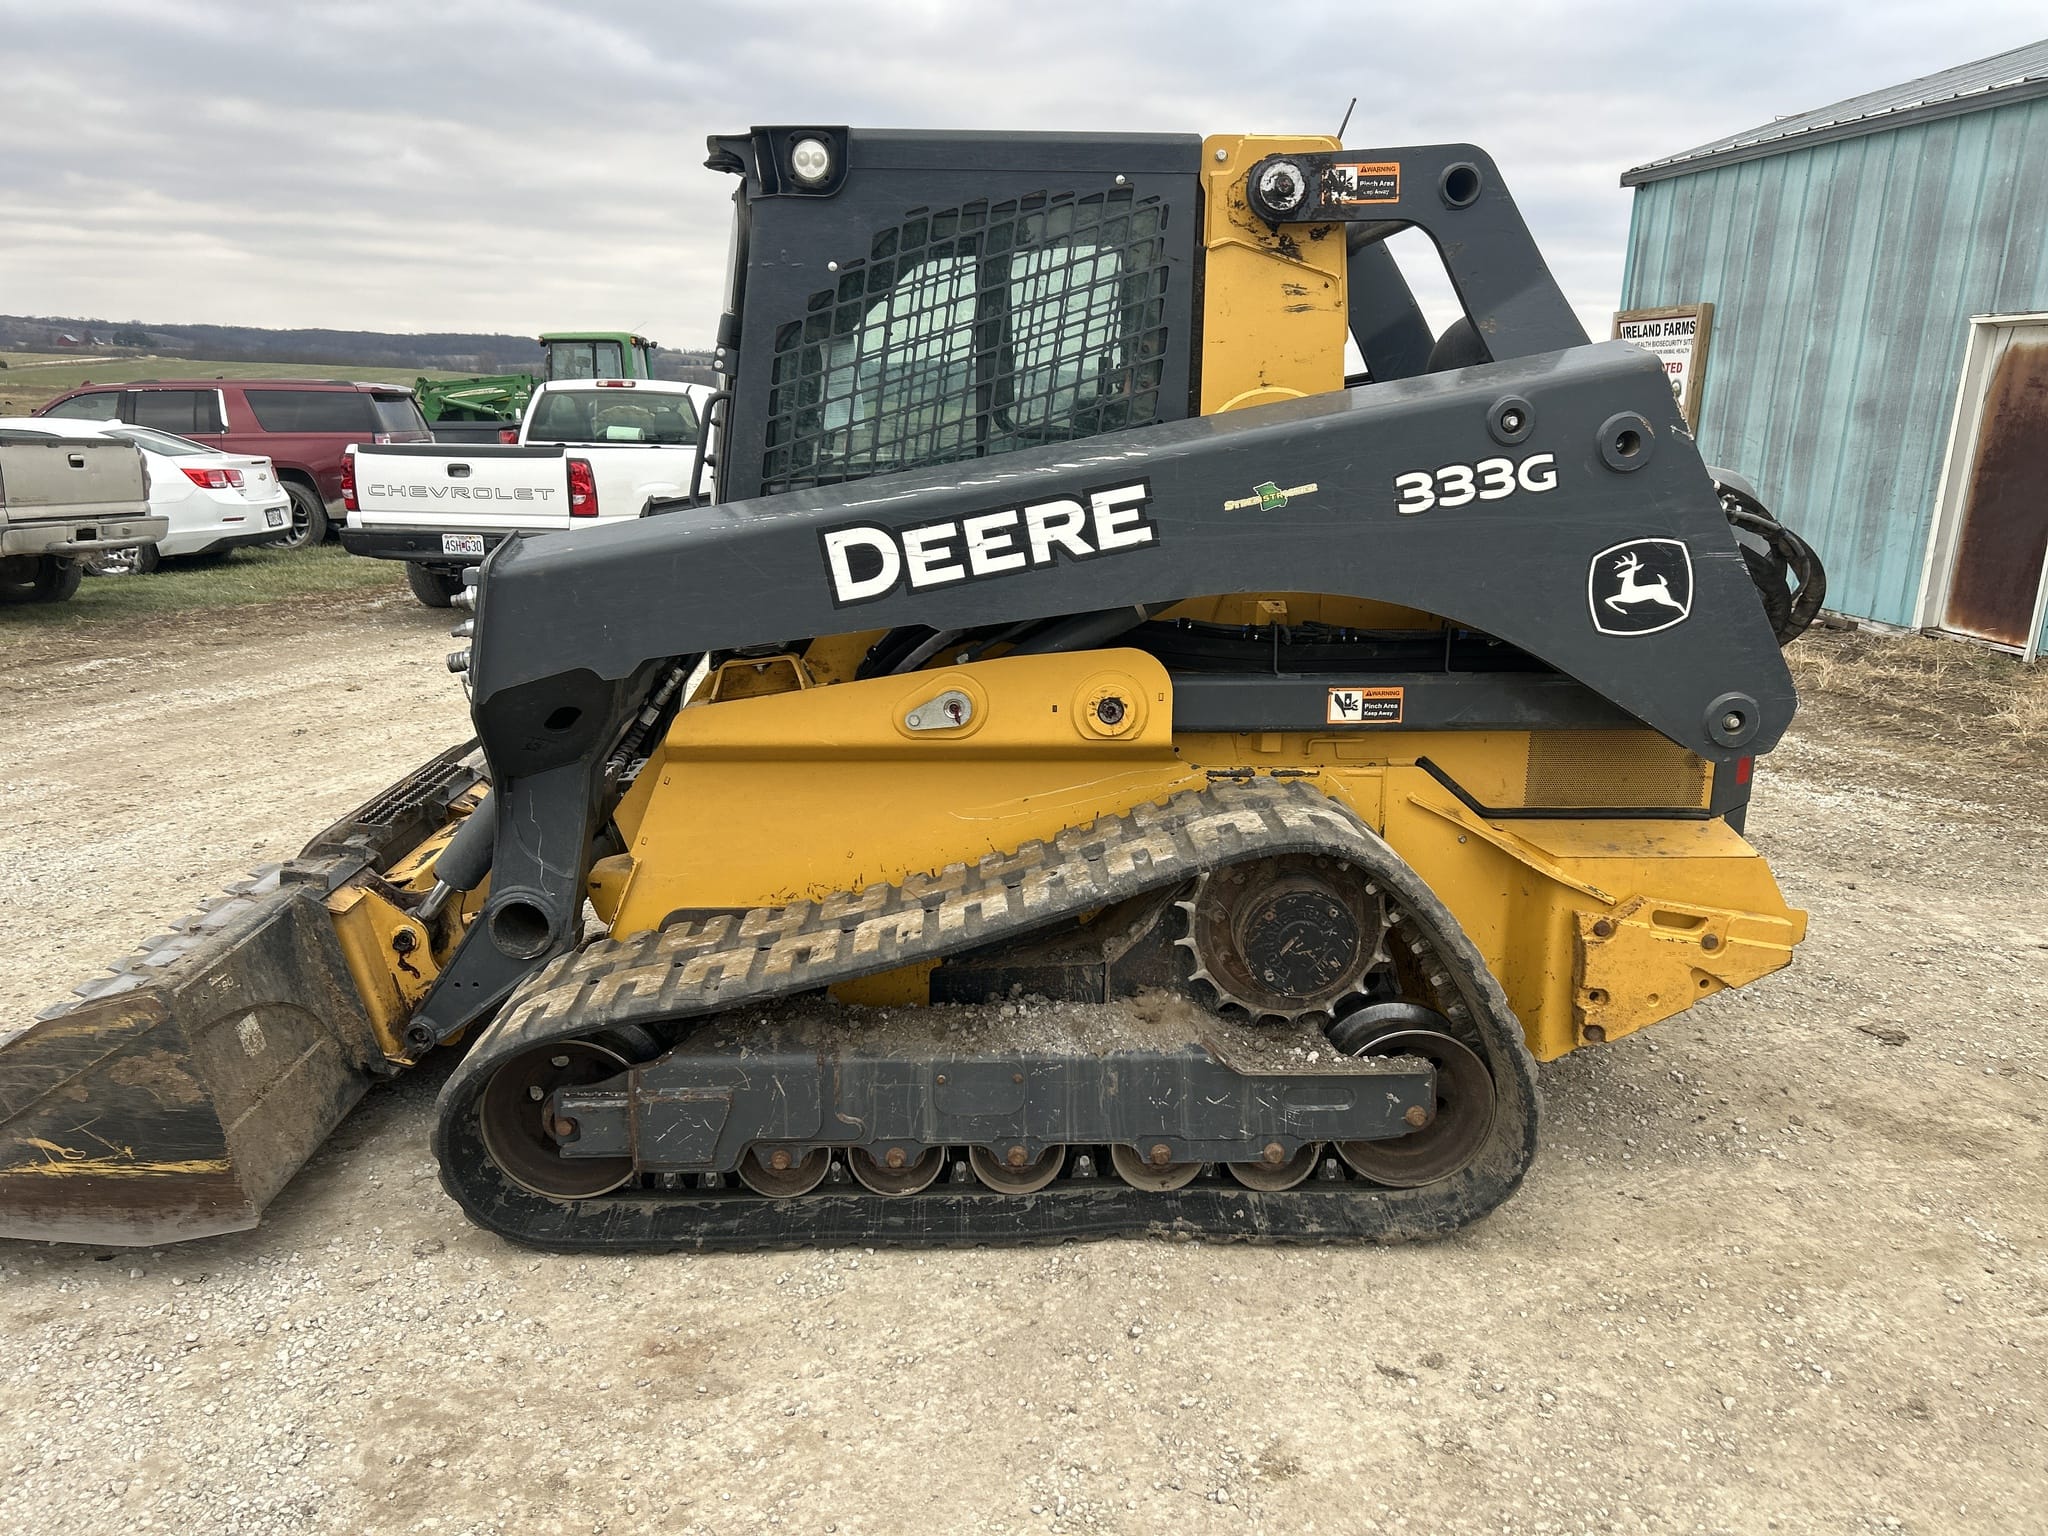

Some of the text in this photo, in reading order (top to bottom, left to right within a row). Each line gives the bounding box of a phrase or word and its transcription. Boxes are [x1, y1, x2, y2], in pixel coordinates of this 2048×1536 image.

[1622, 320, 1696, 339] IRELAND FARMS
[1652, 339, 1682, 348] BIOSECURITY
[1396, 453, 1557, 513] 333G
[368, 484, 555, 500] CHEVROLET
[445, 540, 482, 552] 4SH G30
[824, 484, 1153, 602] DEERE
